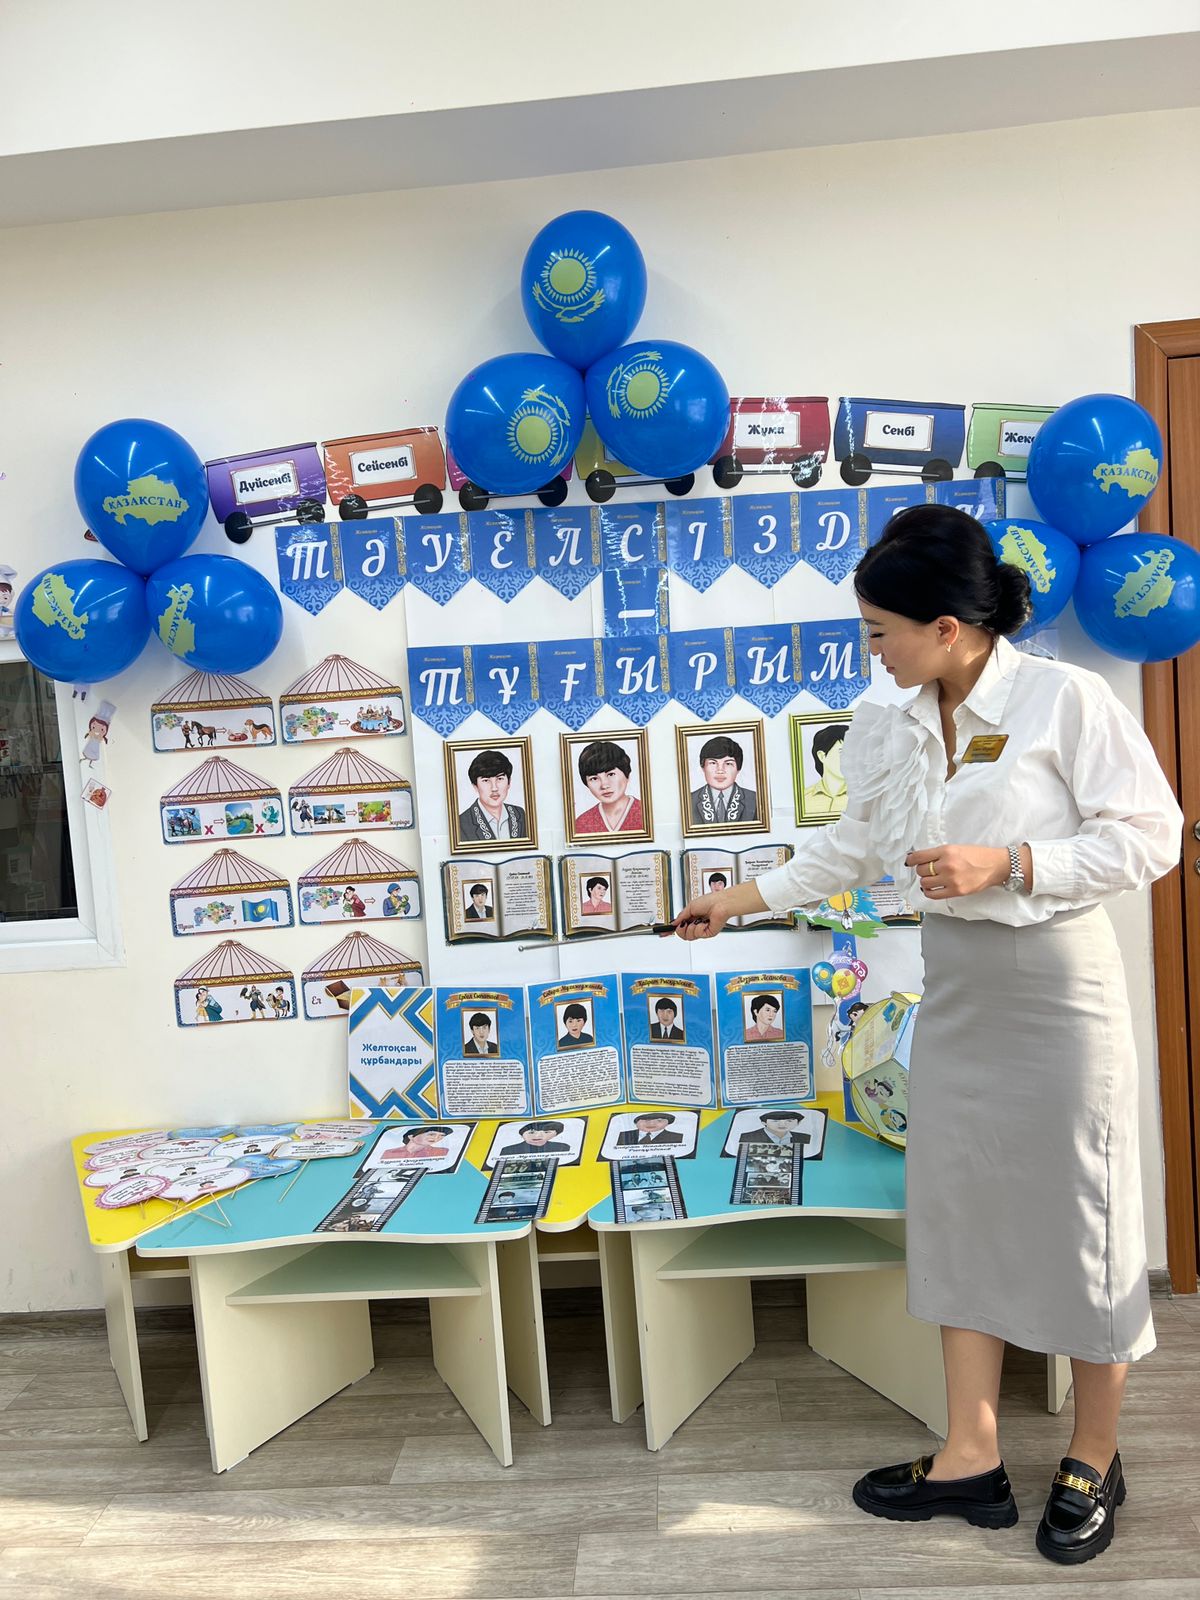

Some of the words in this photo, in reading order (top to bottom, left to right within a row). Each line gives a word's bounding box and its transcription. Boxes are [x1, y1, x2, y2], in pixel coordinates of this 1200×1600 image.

[881, 424, 915, 437] Сенбі
[357, 456, 409, 473] Сейсенбі
[239, 472, 292, 493] Дүйсенбі
[1100, 467, 1157, 485] КАЗАКСТАН
[108, 496, 182, 510] КАЗАКСТАН
[1010, 529, 1047, 588] КАЗАКСТАН
[1121, 553, 1170, 614] КАЗАКСТАН
[43, 578, 80, 634] КАЗАКСТАН
[419, 643, 858, 706] ТҰҒЫРЫМ
[362, 1043, 417, 1053] Желтоқсан
[360, 1056, 422, 1066] құрбандары
